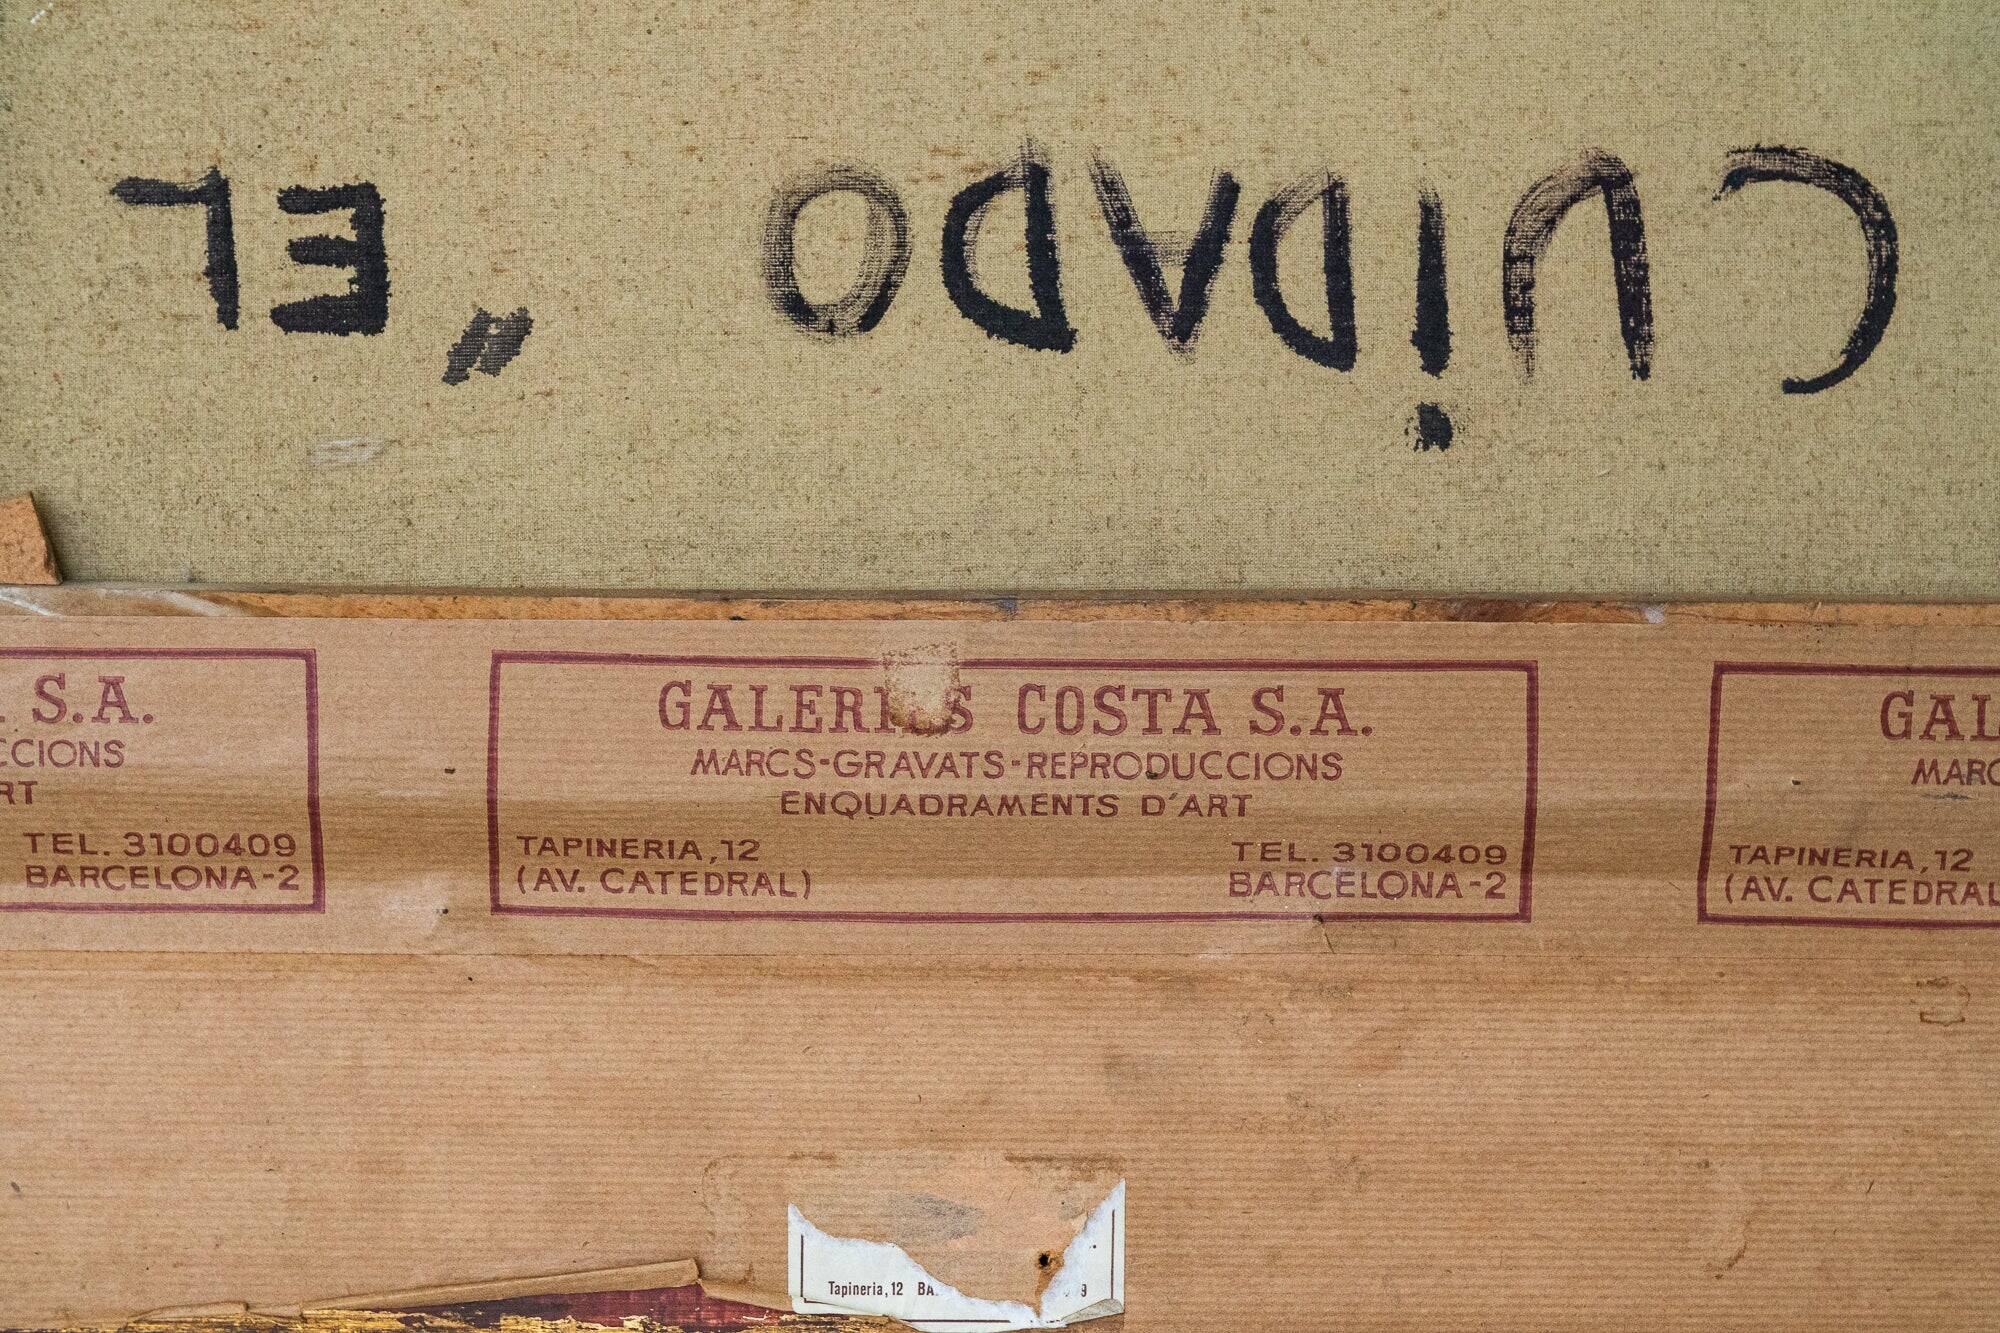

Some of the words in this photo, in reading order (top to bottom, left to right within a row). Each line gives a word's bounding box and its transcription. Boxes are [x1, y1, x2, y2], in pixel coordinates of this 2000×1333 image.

[32, 672, 153, 723] S.A.
[658, 680, 973, 735] GALERIS
[1017, 683, 1221, 737] COSTA
[1249, 685, 1374, 737] S.A.
[1880, 689, 2000, 741] GAL
[781, 791, 1119, 818] ENQUADRAMENTS
[23, 832, 110, 856] TEL.
[123, 831, 297, 858] 3100409
[1231, 841, 1317, 863] TEL.
[1332, 841, 1508, 864] 3100409
[25, 864, 300, 892] BARCELONA-2
[517, 865, 586, 894] (AV.
[600, 867, 811, 900] CATEDRAL)
[1229, 870, 1507, 900] BARCELONA-2
[1725, 873, 1793, 904] (AV.
